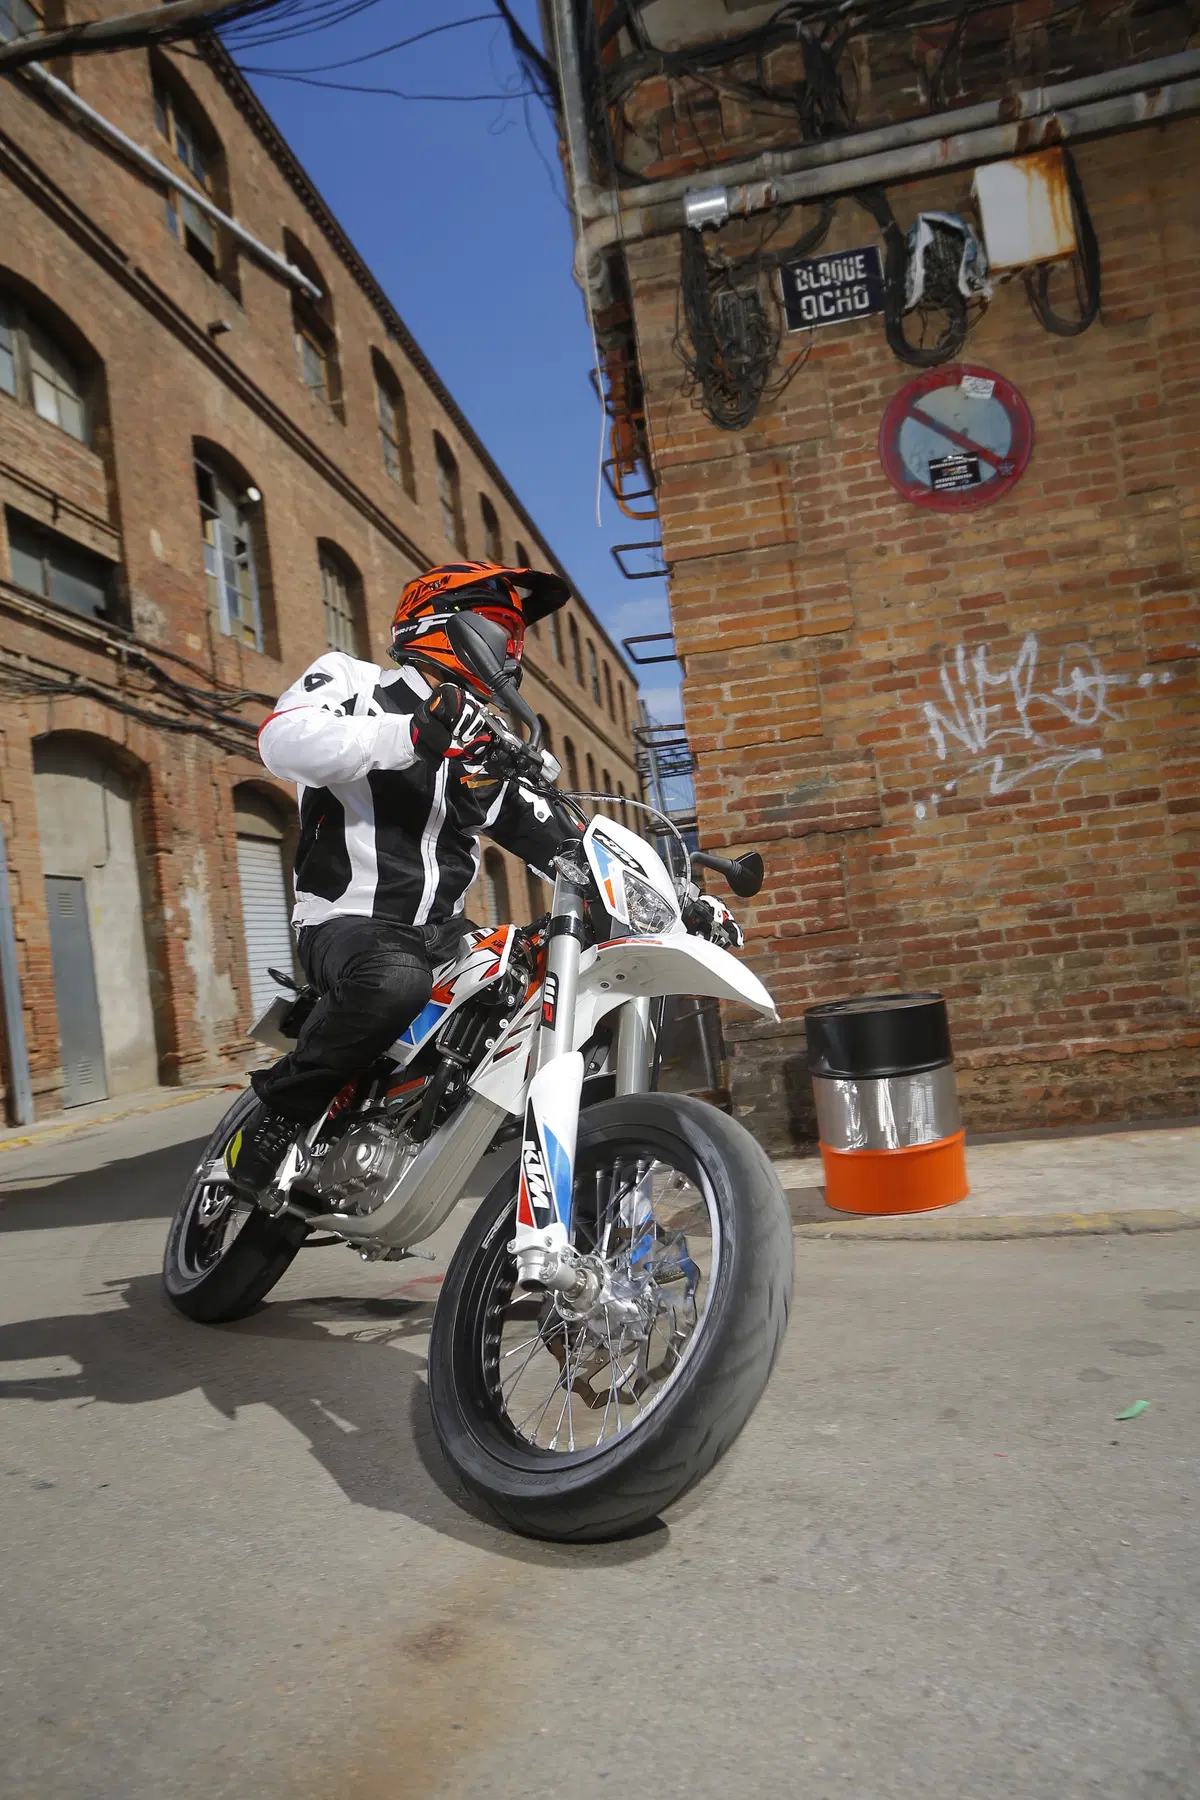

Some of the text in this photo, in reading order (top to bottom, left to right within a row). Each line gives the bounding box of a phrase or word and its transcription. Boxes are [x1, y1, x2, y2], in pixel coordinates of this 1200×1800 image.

[795, 254, 867, 291] BLOQUE
[800, 284, 870, 320] OCHO
[523, 1140, 551, 1209] KTM
